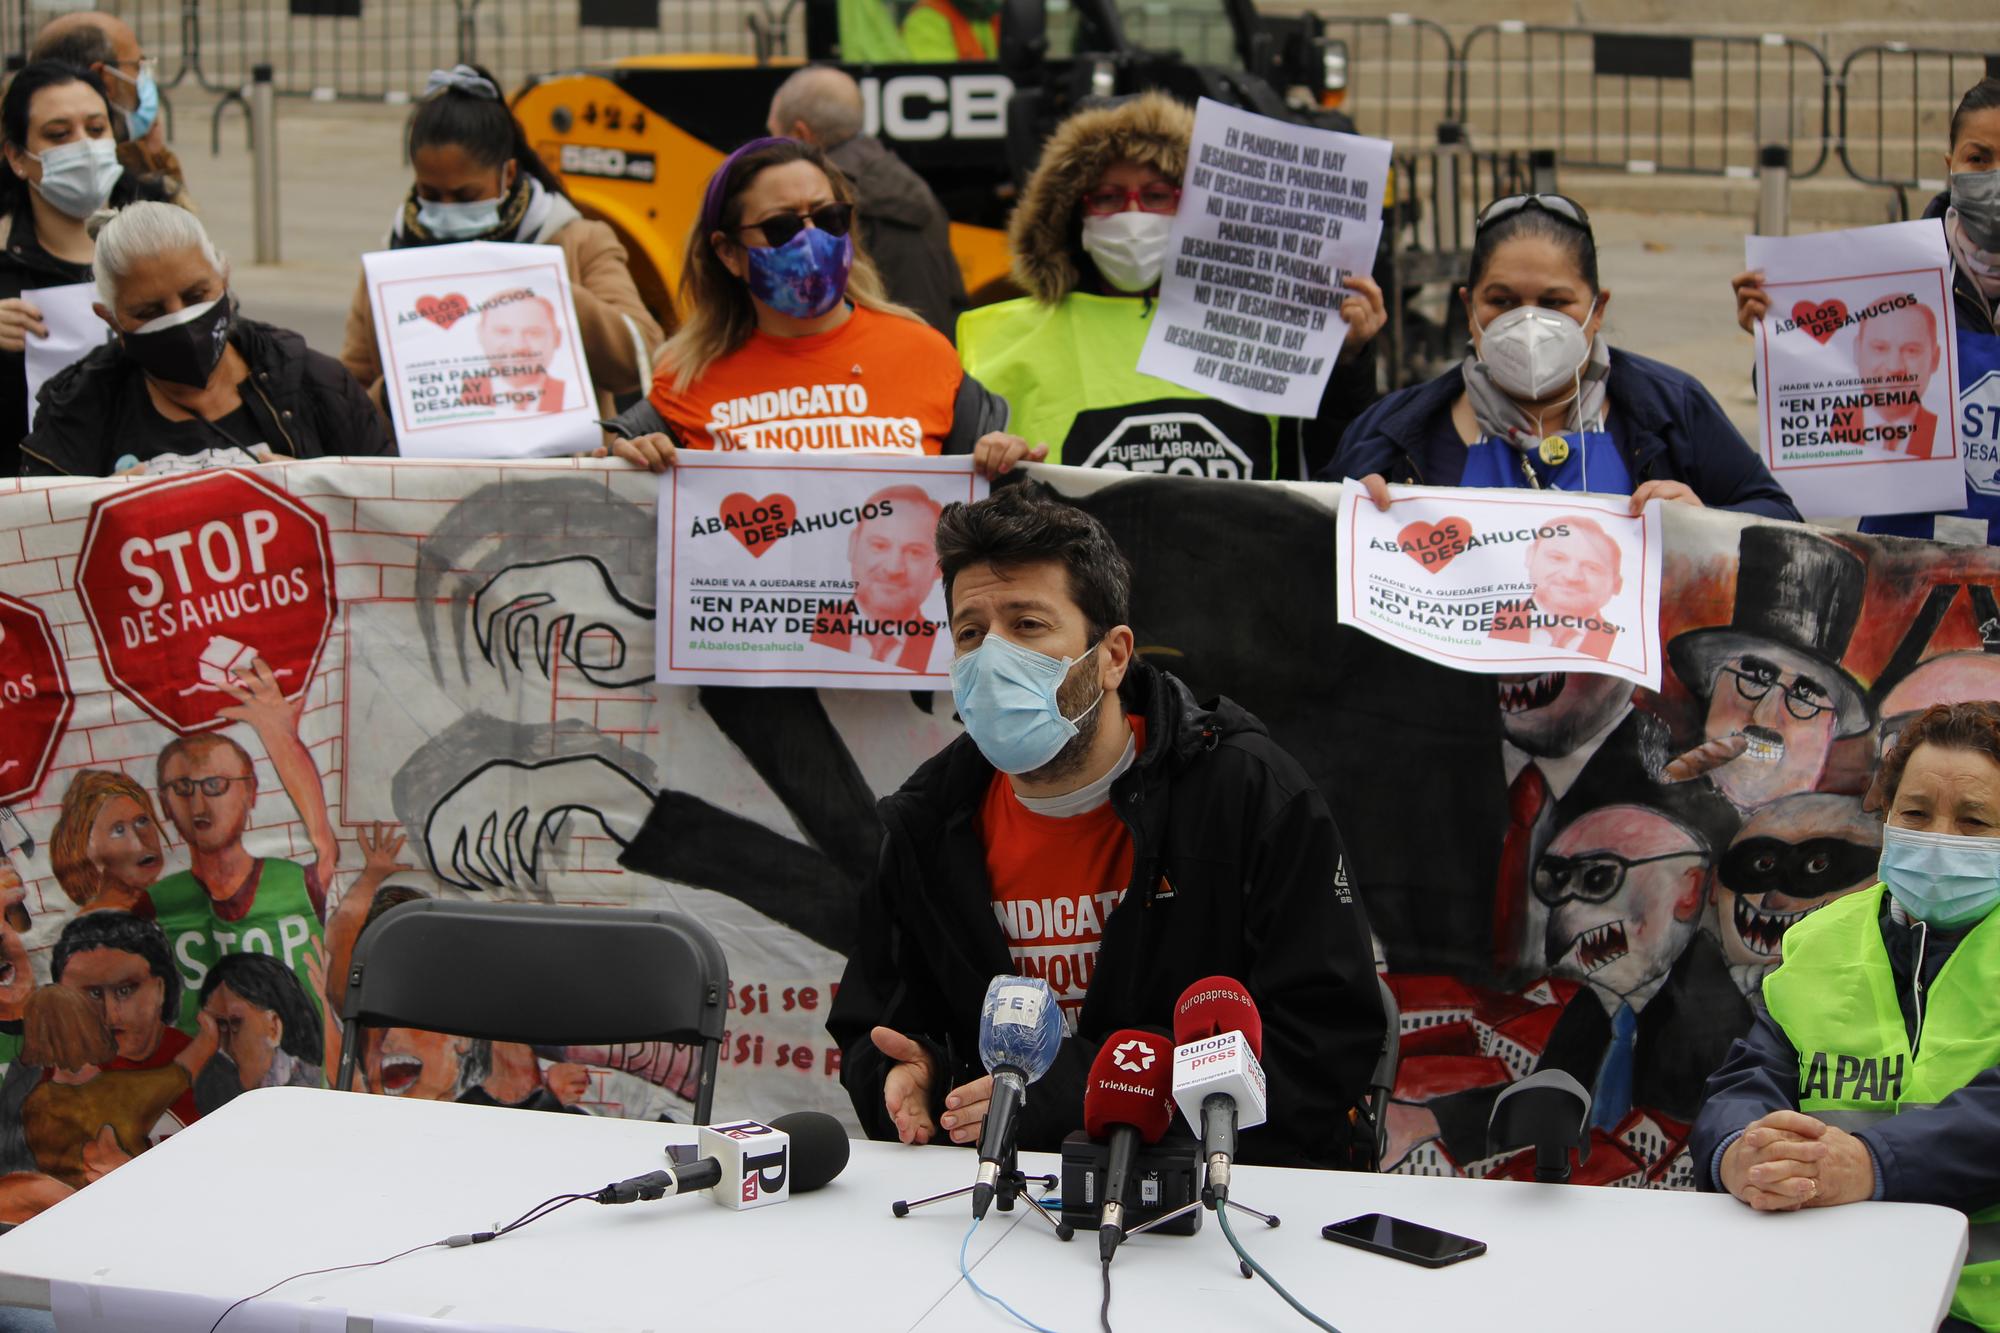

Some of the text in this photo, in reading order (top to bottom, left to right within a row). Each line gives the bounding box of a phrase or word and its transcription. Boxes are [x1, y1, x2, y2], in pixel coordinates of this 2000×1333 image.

[1225, 127, 1347, 172] EN PANDEMIA NO HAY
[1199, 143, 1369, 199] DESAHUCIOS EN PANDEMIA NO
[1192, 166, 1367, 222] HAY DESAHUCIOS EN PANDEMIA
[1205, 196, 1343, 241] NO HAY DESAHUCIOS EN
[1217, 221, 1324, 260] PANDEMIA NO HAY
[1180, 236, 1255, 269] DESAHUCIOS
[1257, 250, 1272, 272] EN
[1274, 255, 1332, 286] PANDEMIA
[1175, 257, 1198, 279] HAY
[1200, 262, 1274, 295] DESAHUCIOS
[1276, 278, 1291, 301] EN
[397, 298, 460, 326] ÁBALOS
[435, 287, 536, 325] DESAHUCIOS
[1194, 284, 1328, 332] NO HAY DESAHUCIOS EN
[1775, 306, 1839, 336] ÁBALOS
[1811, 293, 1918, 338] DESAHUCIOS
[1203, 310, 1308, 352] PANDEMIA NO HAY
[1163, 324, 1237, 361] DESAHUCIOS
[1238, 341, 1255, 365] EN
[1255, 344, 1311, 376] PANDEMIA
[408, 363, 548, 385] “EN PANDEMIA
[1193, 357, 1290, 396] HAY DESAHUCIOS
[1778, 374, 1919, 392] ¿NADIE VA A QUEDARSE ATRÁS?
[411, 381, 483, 400] NO HAY
[710, 384, 868, 428] SINDICATO
[1779, 390, 1922, 413] “EN PANDEMIA
[1150, 423, 1181, 440] PAH
[1781, 411, 1854, 431] NO HAY
[1781, 424, 1917, 448] DESAHUCIOS”
[755, 423, 916, 452] INQUILINAS
[1108, 441, 1226, 462] FUENLABRADA
[690, 503, 784, 538] ÁBALOS
[744, 500, 893, 546] DESAHUCIOS
[1369, 524, 1460, 553] ÁBALOS
[1421, 524, 1571, 565] DESAHUCIOS
[119, 509, 280, 609] STOP
[690, 577, 860, 590] ¿NADIE VA A QUEDARSE ATRÁS?
[1369, 573, 1406, 589] ¿NADIE
[1409, 585, 1423, 593] VA
[1436, 584, 1493, 597] QUEDARSE
[1497, 581, 1538, 592] ATRÁS?
[120, 566, 310, 650] DESAHUCIOS
[690, 597, 860, 615] “EN PANDEMIA
[1369, 585, 1539, 617] “EN PANDEMIA
[1369, 596, 1626, 635] NO HAY DESAHUCIOS”
[690, 616, 947, 637] NO HAY DESAHUCIOS”
[689, 640, 805, 653] #ÁbalosDesahucia
[991, 888, 1128, 940] NDICAT
[782, 986, 819, 1012] se
[1180, 988, 1252, 1014] europapress.es
[776, 1043, 814, 1070] se
[1180, 1035, 1236, 1057] europa
[1191, 1049, 1236, 1070] press
[1099, 1080, 1155, 1096] TeleMadrid
[1833, 1054, 1904, 1101] PAH
[742, 1144, 787, 1193] P
[745, 1181, 755, 1198] TV
